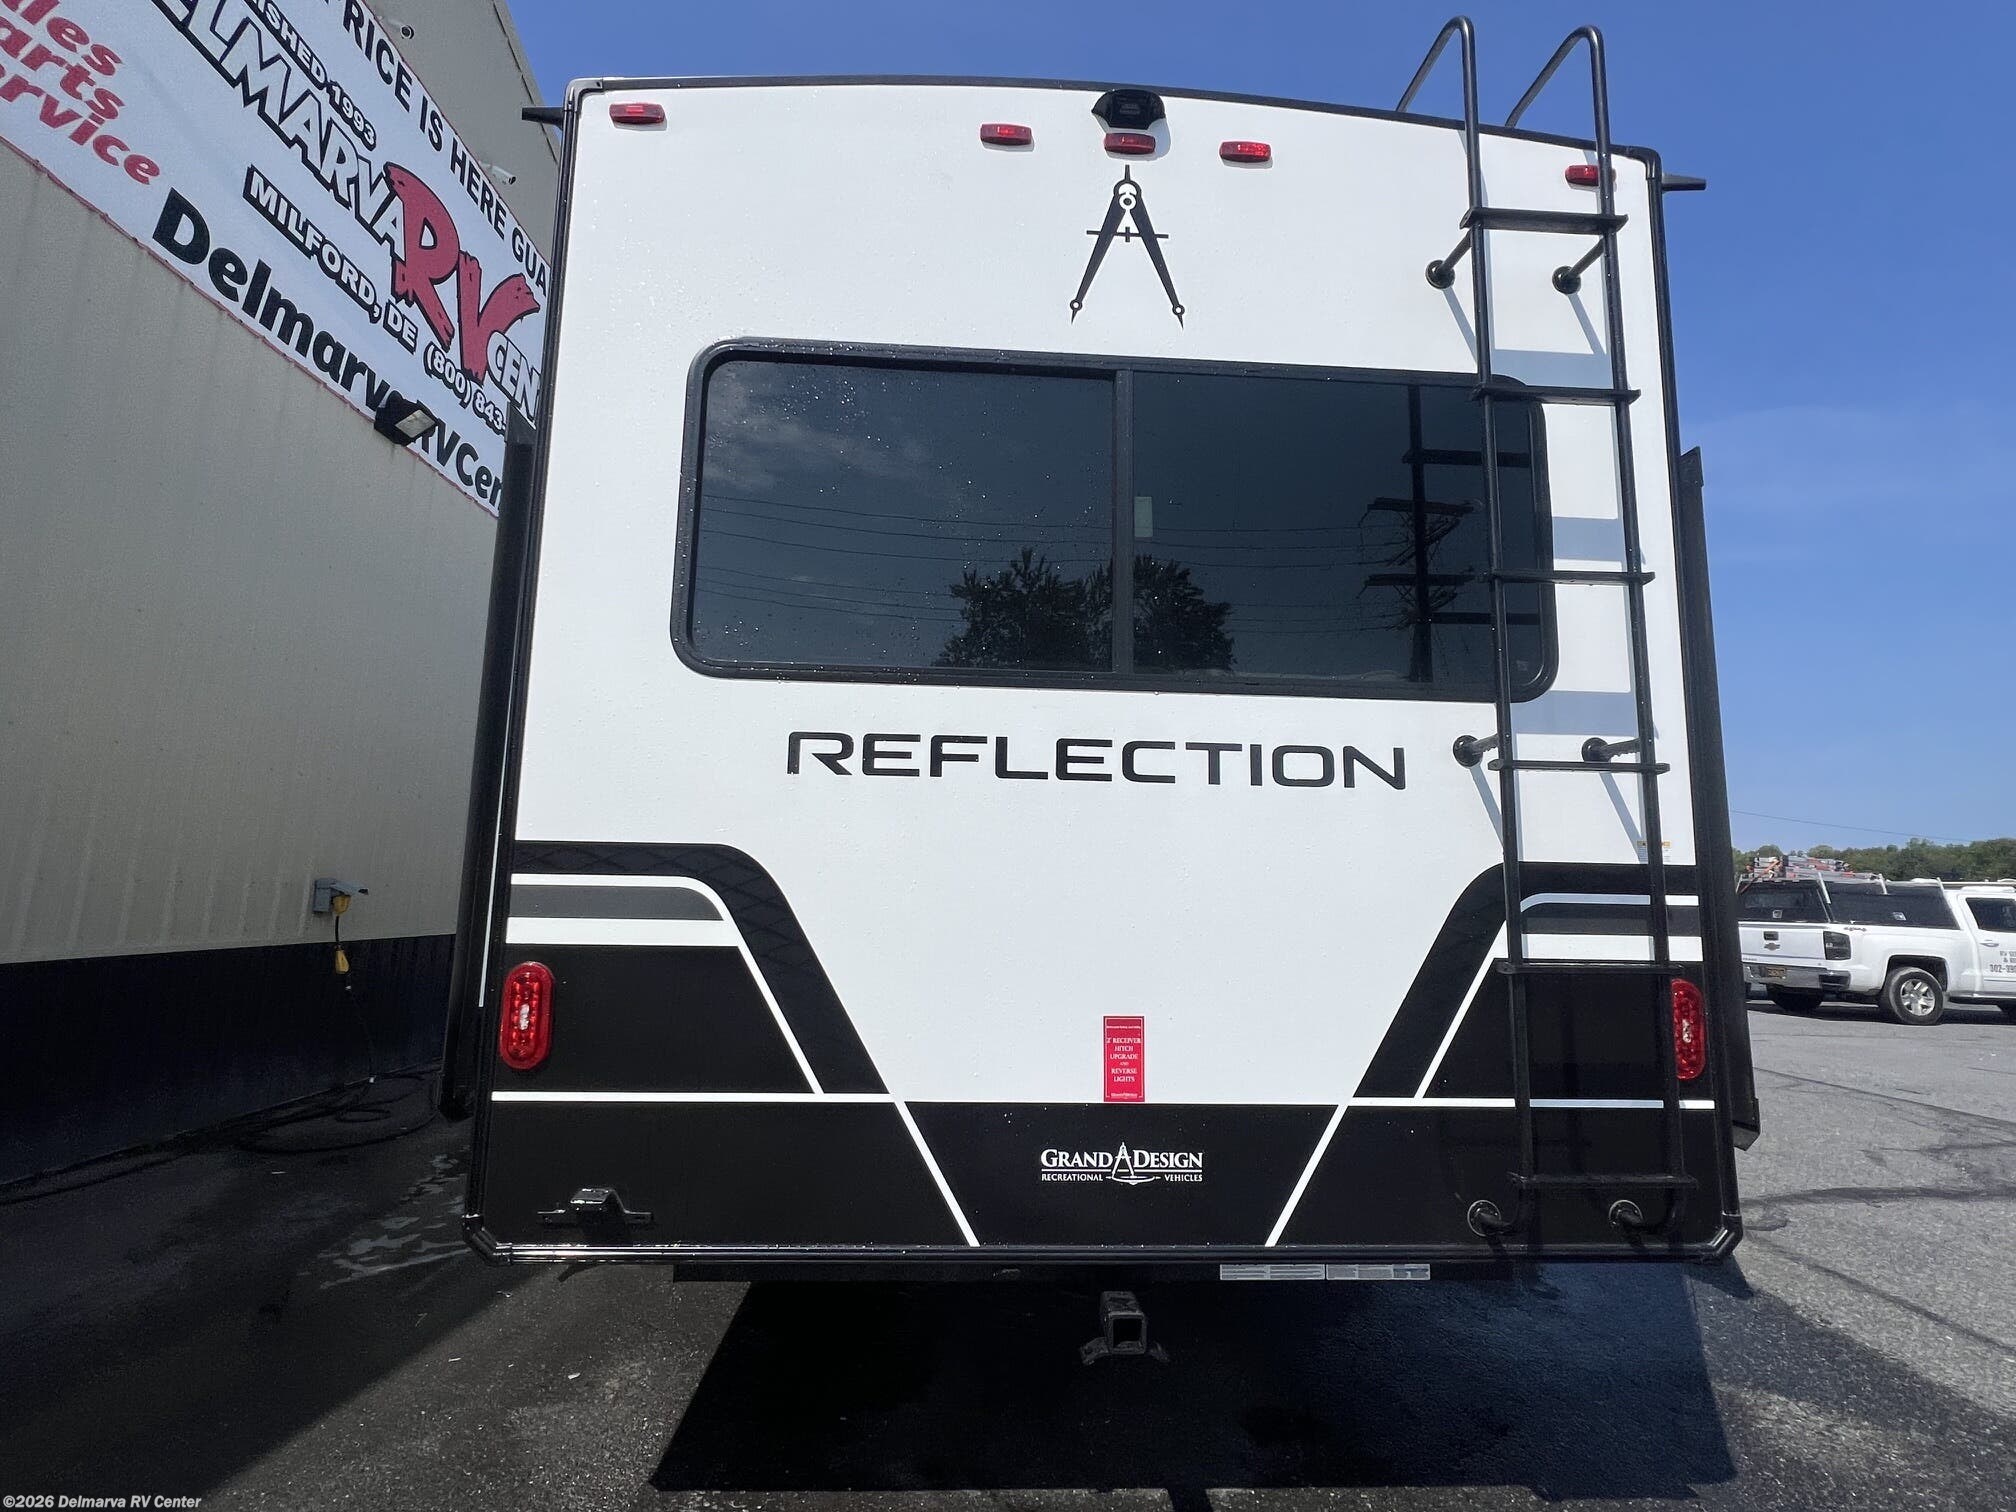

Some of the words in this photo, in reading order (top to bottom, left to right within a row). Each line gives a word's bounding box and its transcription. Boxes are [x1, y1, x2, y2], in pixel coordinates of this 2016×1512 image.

[0, 63, 160, 185] rvice
[249, 0, 327, 87] ISHED
[329, 81, 377, 149] 1993
[322, 0, 412, 112] RICE
[419, 95, 443, 152] IS
[450, 138, 507, 241] HERE
[245, 165, 381, 322] MILFORD,
[383, 300, 418, 354] DE
[424, 342, 473, 408] (800)
[386, 161, 541, 385] RV
[786, 731, 1407, 791] REFLECTION
[1040, 1149, 1114, 1168] GRAND
[1133, 1149, 1203, 1168] DESIGN
[1041, 1173, 1104, 1182] RECREATIONAL
[1164, 1173, 1203, 1182] VEHICLES
